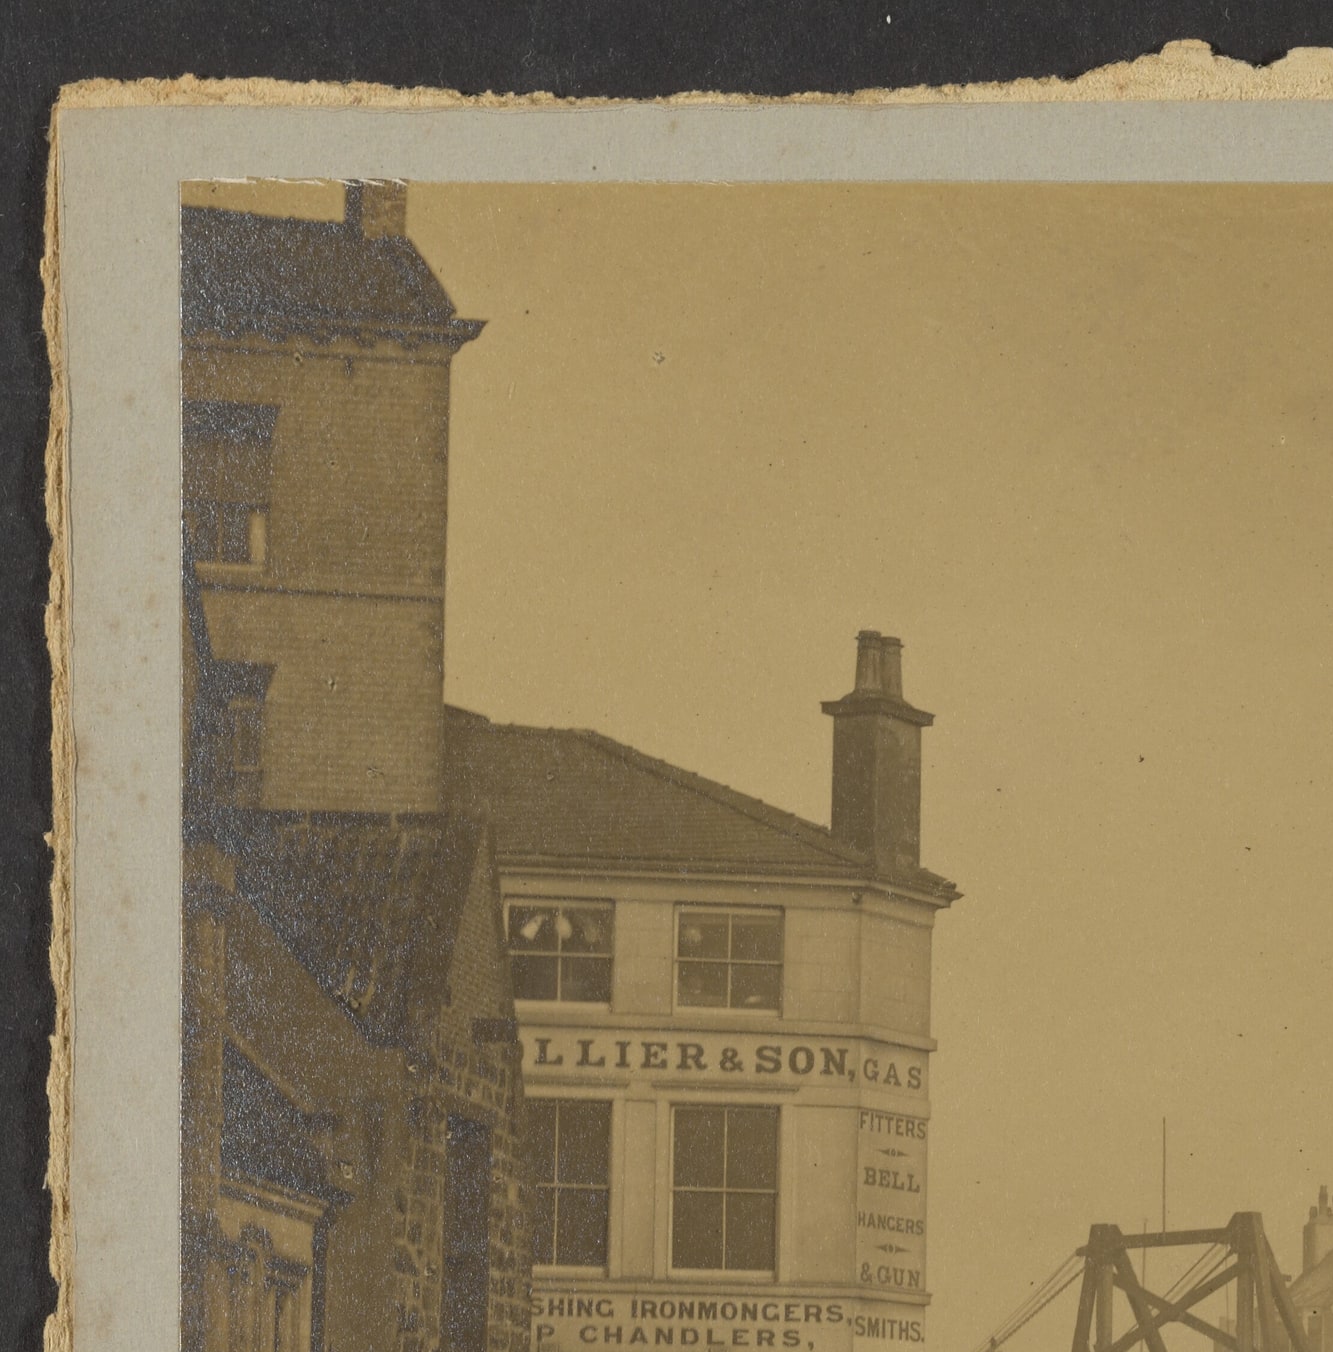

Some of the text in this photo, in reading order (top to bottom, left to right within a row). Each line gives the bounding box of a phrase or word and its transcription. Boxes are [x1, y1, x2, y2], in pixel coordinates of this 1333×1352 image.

[521, 1038, 856, 1082] LLIER & SON,
[863, 1058, 922, 1090] GAS
[860, 1111, 927, 1140] FITTERS
[863, 1166, 920, 1194] BELL
[858, 1210, 924, 1236] HANGERS
[860, 1262, 920, 1289] & GUN
[630, 1299, 853, 1327] IRONMONGERS,
[579, 1324, 815, 1352] CHANDLERS,
[855, 1315, 925, 1343] SMITHS.
